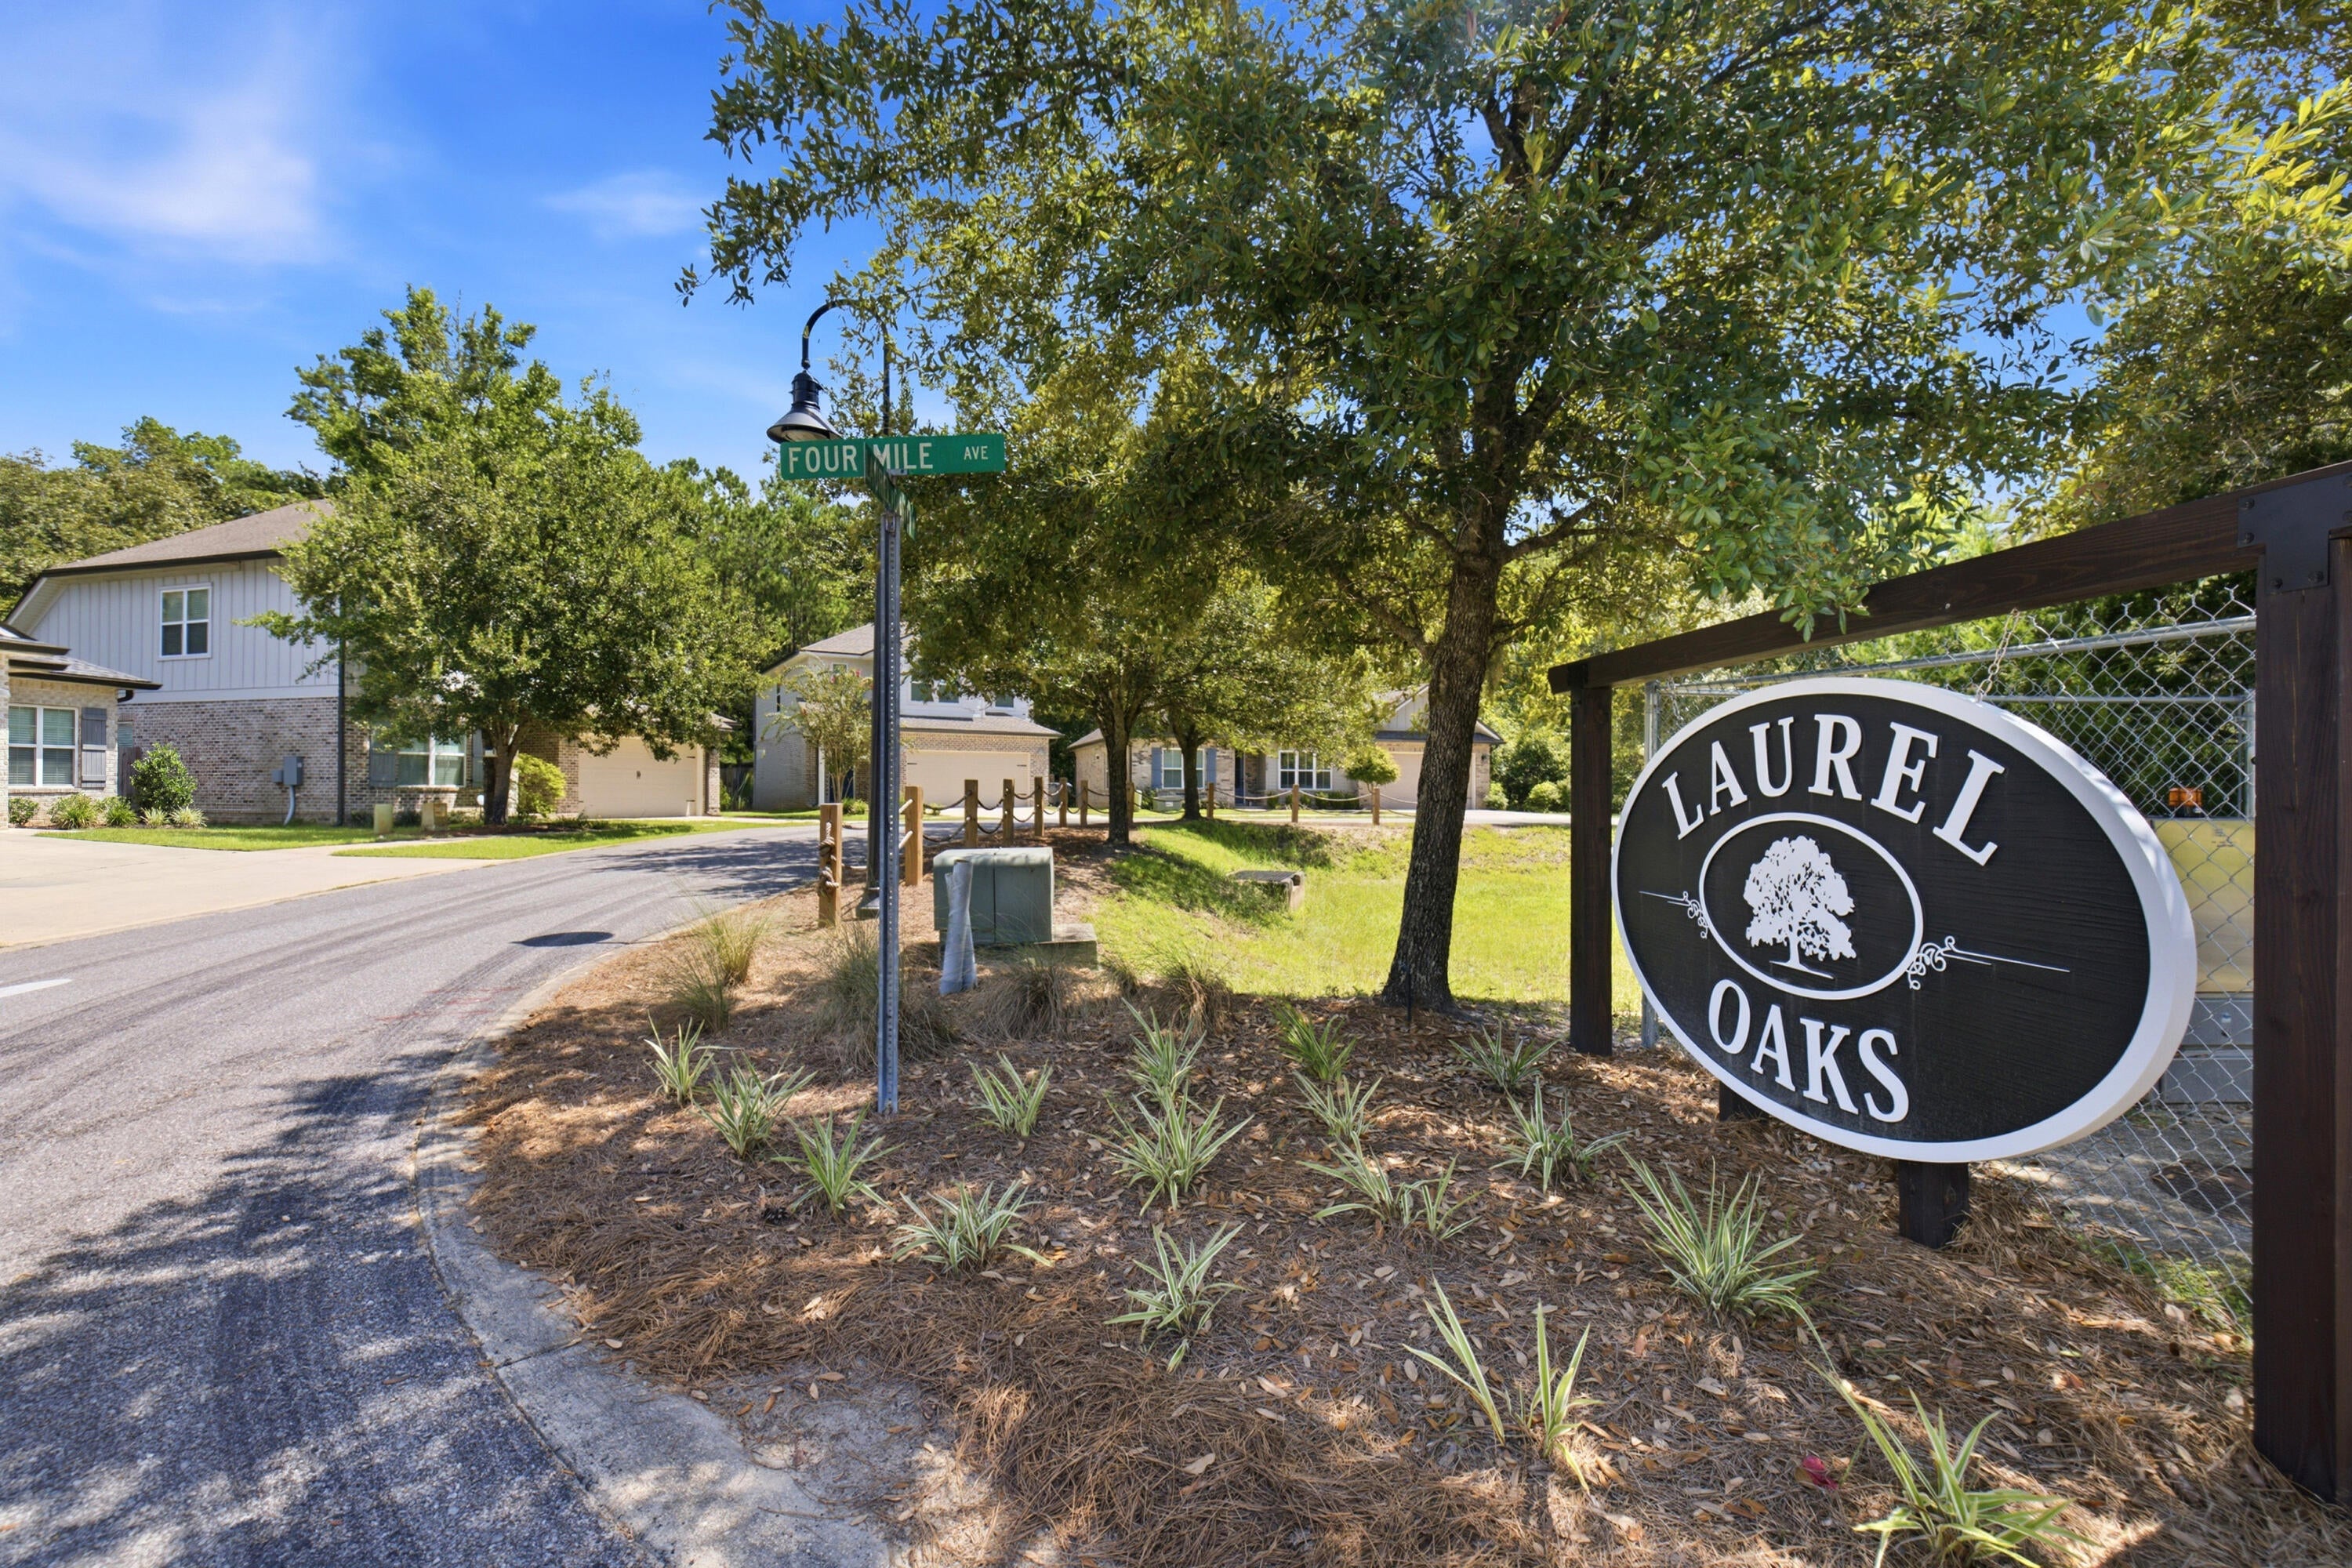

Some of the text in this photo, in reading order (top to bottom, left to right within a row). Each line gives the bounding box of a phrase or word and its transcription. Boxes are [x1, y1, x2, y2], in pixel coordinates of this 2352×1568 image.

[789, 442, 989, 474] FOUR MILE AVE
[1662, 714, 2005, 866] LAUREL
[1708, 979, 1910, 1123] OAKS
